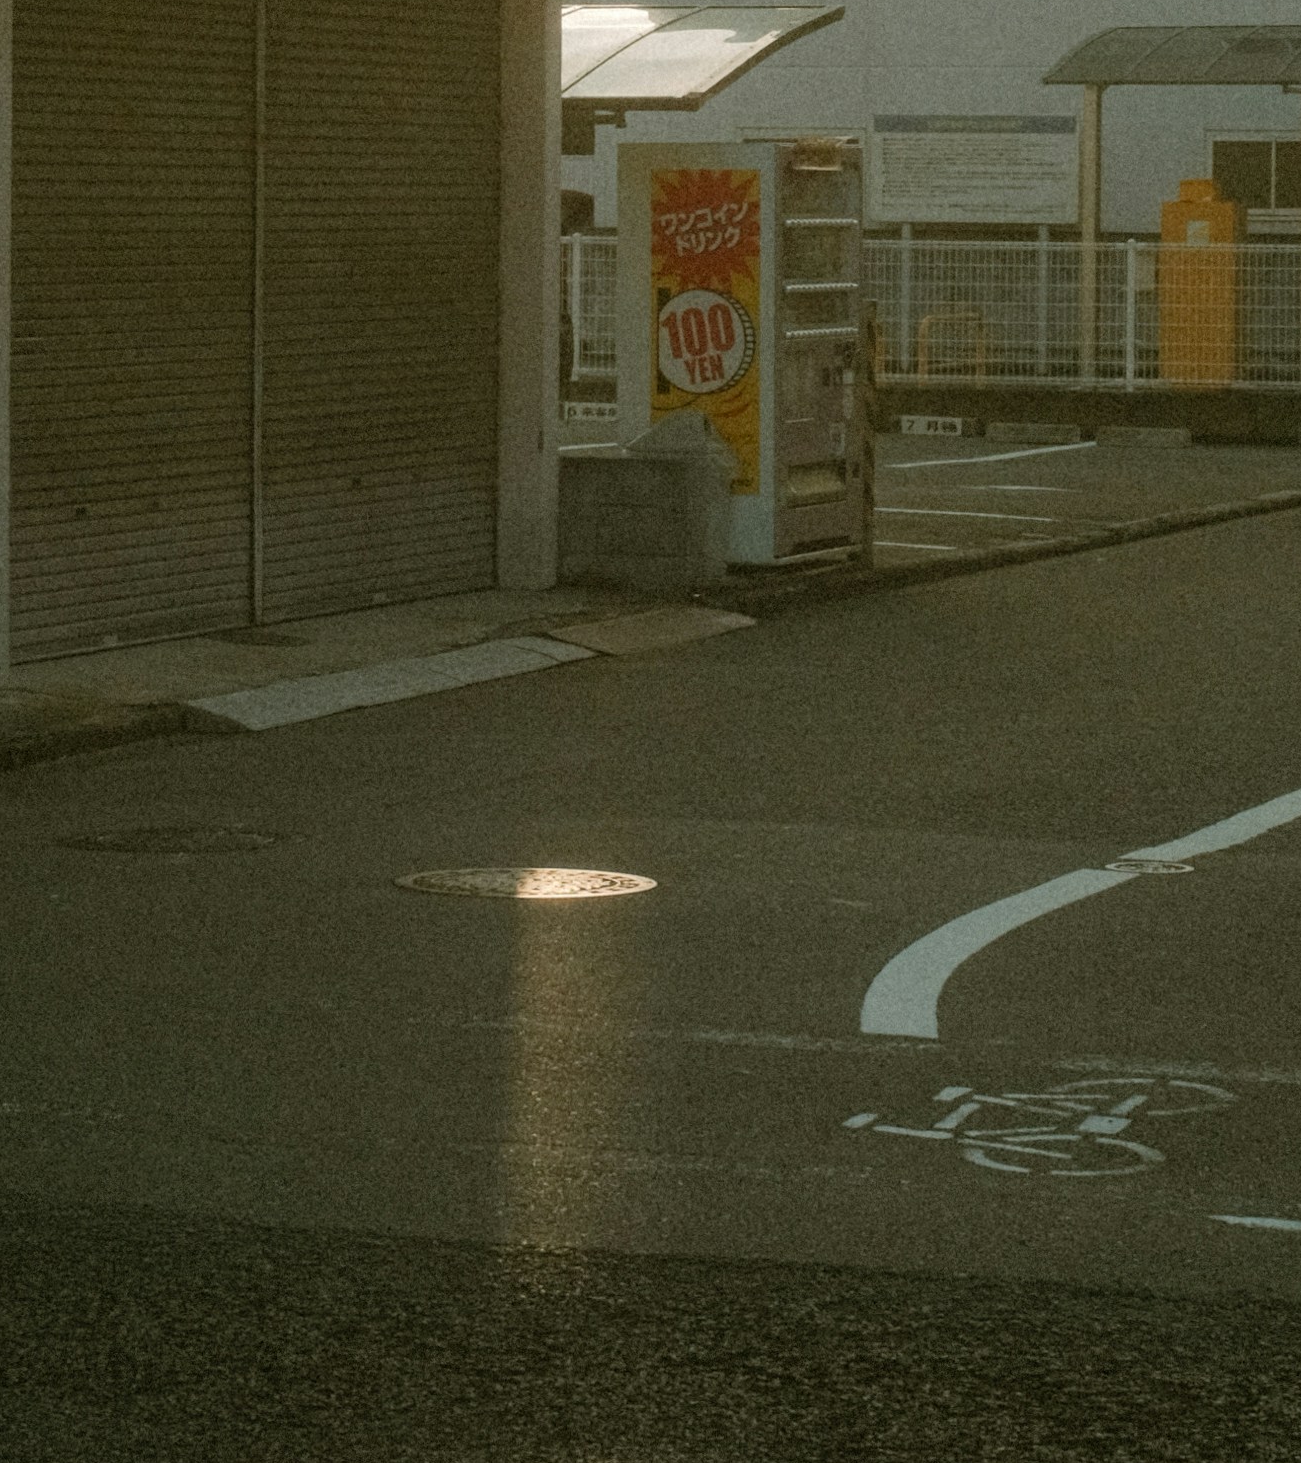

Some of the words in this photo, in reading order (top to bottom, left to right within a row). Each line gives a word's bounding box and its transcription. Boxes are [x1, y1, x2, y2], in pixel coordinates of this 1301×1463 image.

[660, 201, 750, 235] ワンコイン
[675, 226, 742, 257] ドリンク
[661, 303, 736, 359] 100
[684, 356, 725, 385] YEN
